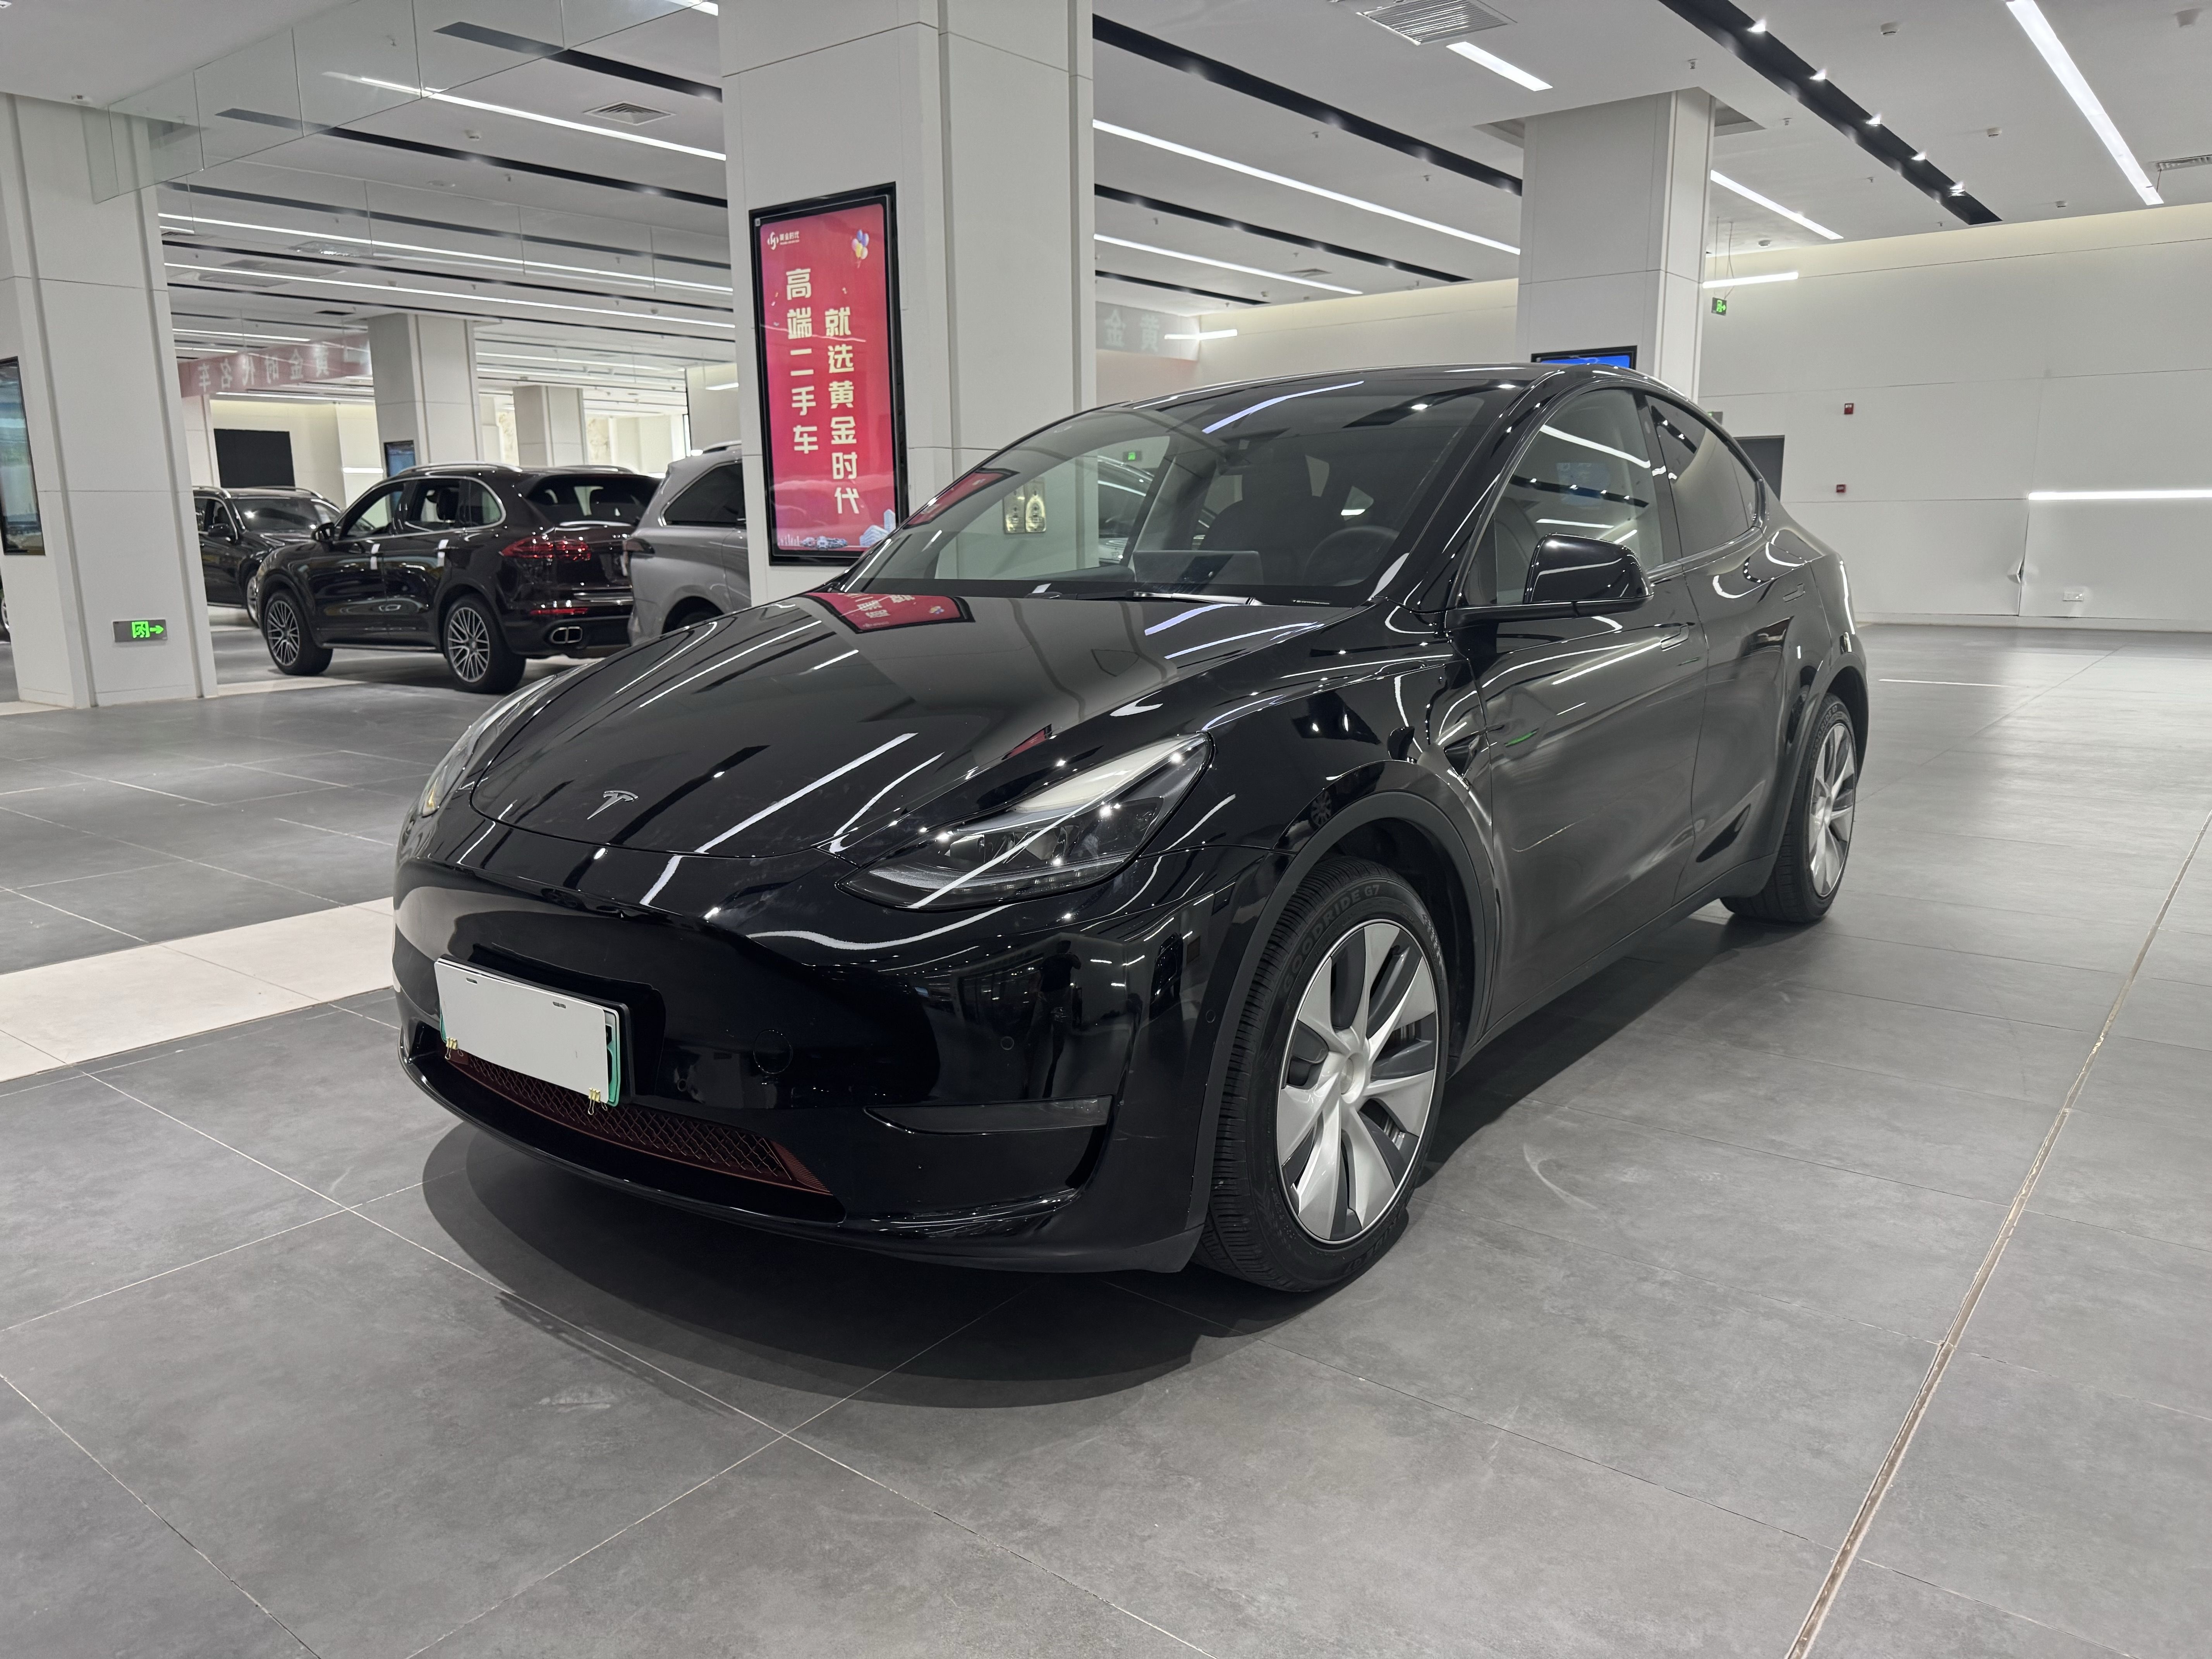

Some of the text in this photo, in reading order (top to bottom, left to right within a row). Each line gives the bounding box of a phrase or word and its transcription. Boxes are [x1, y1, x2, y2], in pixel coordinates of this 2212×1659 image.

[785, 268, 819, 454] 高端二手车
[825, 307, 860, 514] 就选黄金时代
[1283, 884, 1380, 993] GOODRIDE G7
